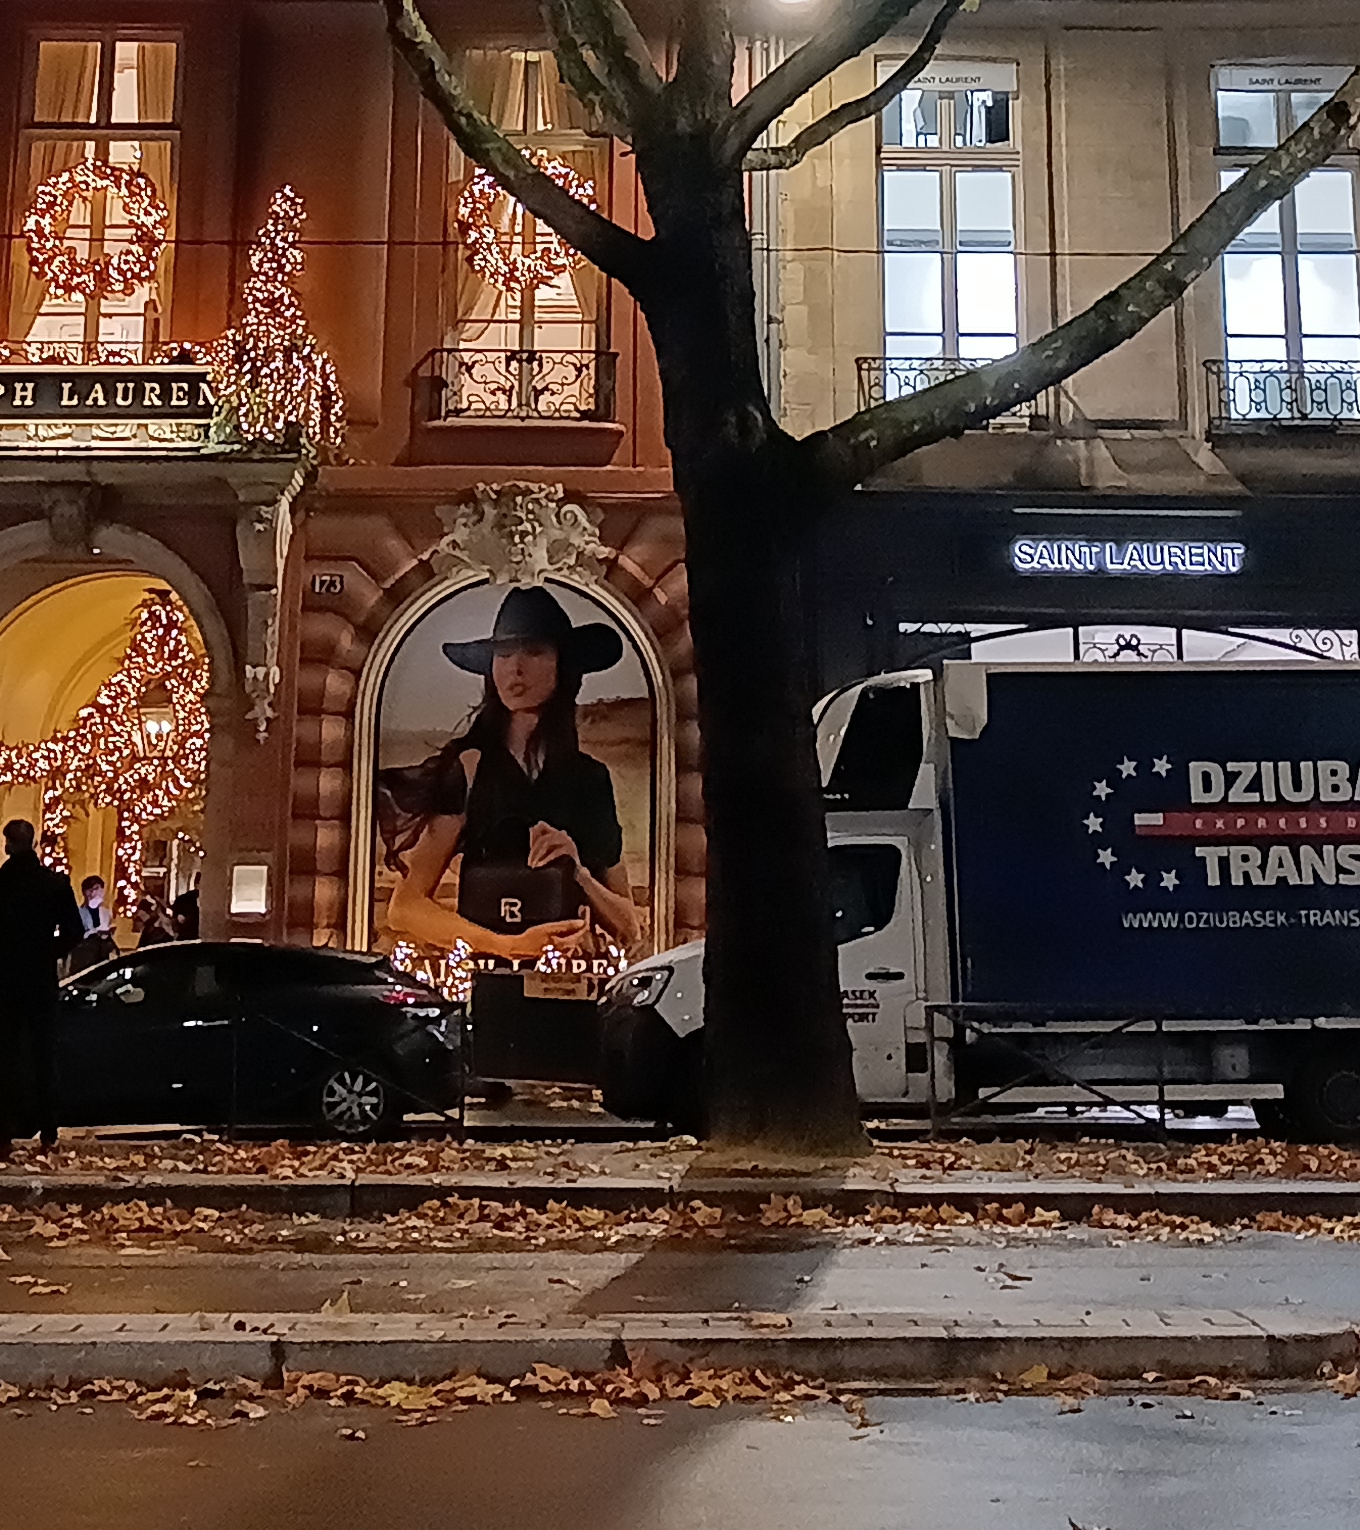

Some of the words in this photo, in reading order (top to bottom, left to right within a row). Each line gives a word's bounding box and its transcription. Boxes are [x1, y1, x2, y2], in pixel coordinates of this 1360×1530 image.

[1014, 540, 1101, 570] SAINT
[1104, 542, 1245, 571] LAURENT
[314, 574, 341, 593] 173
[1194, 815, 1328, 830] EXPRESS
